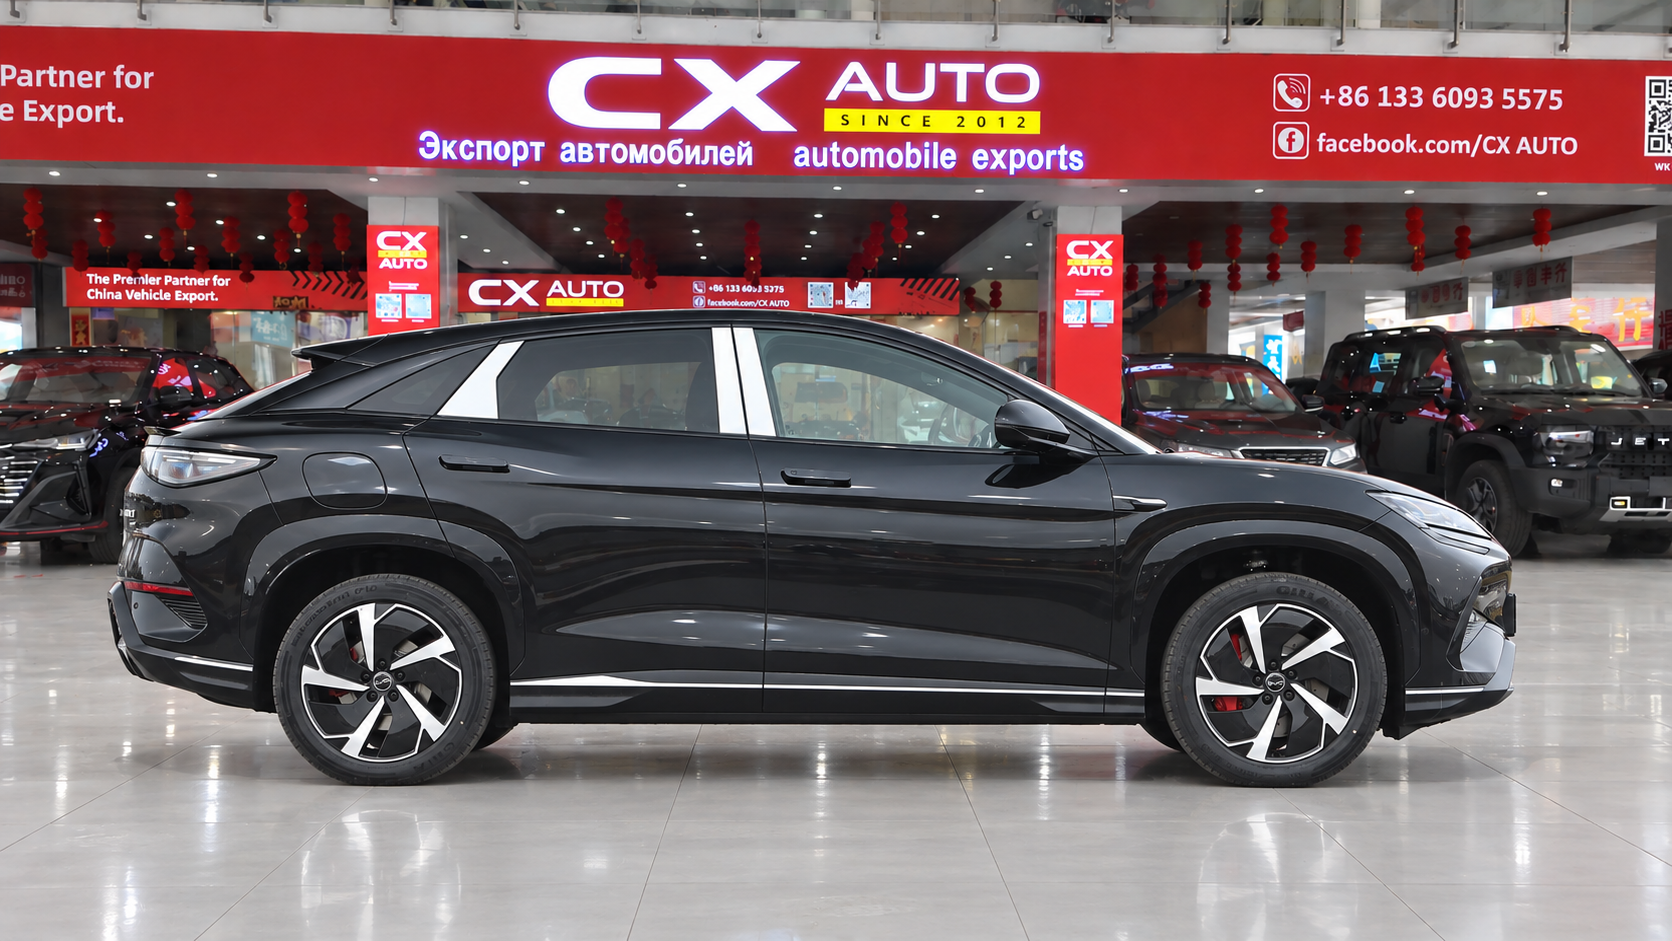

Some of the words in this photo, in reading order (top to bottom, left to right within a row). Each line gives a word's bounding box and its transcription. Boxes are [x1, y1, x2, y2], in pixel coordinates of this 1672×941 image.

[0, 64, 106, 88] Partner
[113, 64, 155, 89] for
[547, 56, 801, 132] CX
[826, 61, 1041, 104] AUTO
[1320, 85, 1369, 107] +86
[1378, 85, 1424, 108] 133
[1432, 86, 1494, 109] 6093
[1502, 88, 1563, 111] 5575
[23, 100, 124, 129] Export.
[841, 114, 931, 128] SINCE
[956, 115, 1026, 129] 2012
[418, 130, 546, 167] Экспорт
[560, 137, 754, 166] автомобилей
[1316, 132, 1511, 158] facebook.com/CX
[1515, 136, 1578, 155] AUTO
[793, 141, 958, 170] automobile
[972, 144, 1085, 176] exports
[376, 230, 427, 251] CX
[1066, 240, 1114, 260] CX
[378, 258, 428, 270] AUTO
[1066, 266, 1113, 277] AUTO
[86, 273, 110, 285] The
[113, 273, 162, 286] Premier
[164, 275, 211, 287] Partner
[212, 275, 232, 287] for
[86, 288, 122, 300] China
[125, 288, 172, 301] Vehicle
[175, 290, 219, 304] Export.
[468, 279, 540, 307] CX
[546, 280, 625, 298] AUTO
[769, 300, 790, 308] AUTO
